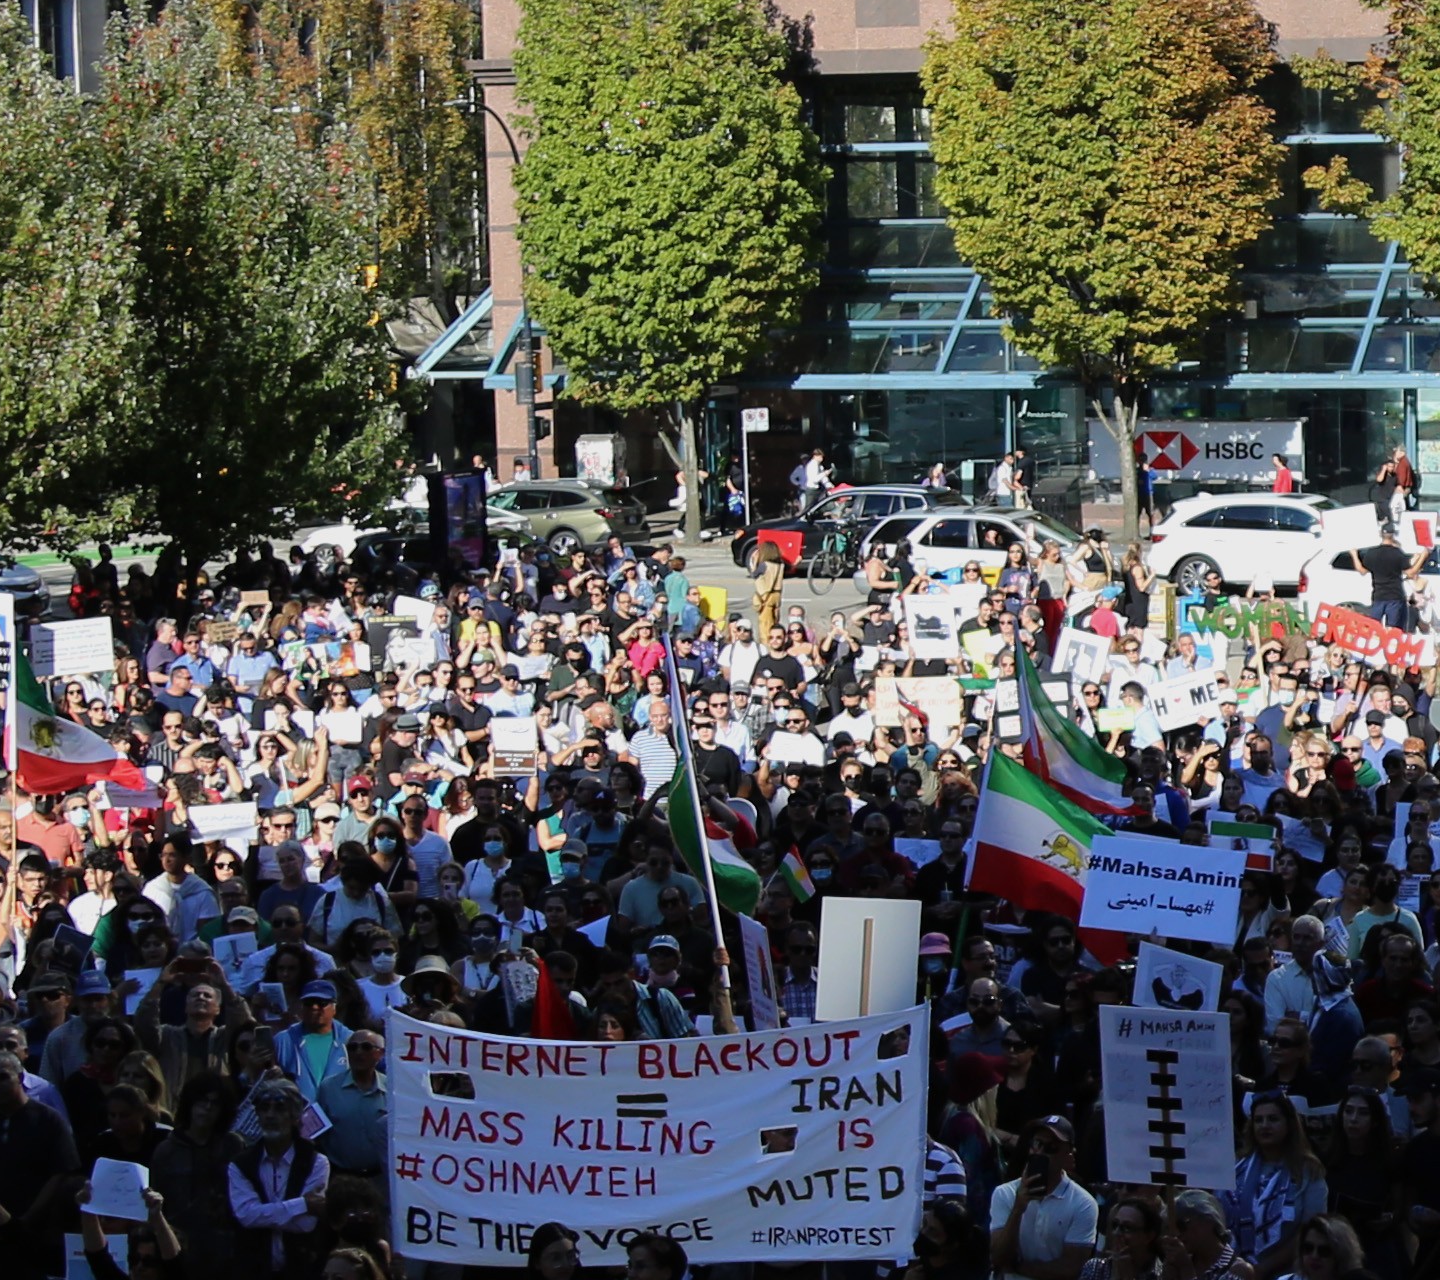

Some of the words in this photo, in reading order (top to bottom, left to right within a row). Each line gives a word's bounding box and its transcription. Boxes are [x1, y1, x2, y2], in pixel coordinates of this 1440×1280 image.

[1205, 442, 1265, 461] HSBC
[1312, 601, 1426, 675] FREEDOM
[1088, 854, 1245, 889] #MahsaAmini
[1141, 1019, 1182, 1034] MAHSA
[401, 1033, 609, 1077] INTERNET
[638, 1031, 860, 1079] BLACKOUT
[792, 1070, 902, 1114] IRAN
[420, 1105, 525, 1146] MASS
[554, 1115, 716, 1156] KILLING
[838, 1119, 874, 1151] IS
[396, 1154, 657, 1197] #OSHNAVIEH
[748, 1165, 905, 1208] MUTED
[407, 1207, 458, 1245] BE
[752, 1227, 896, 1248] #IRANPROTEST
